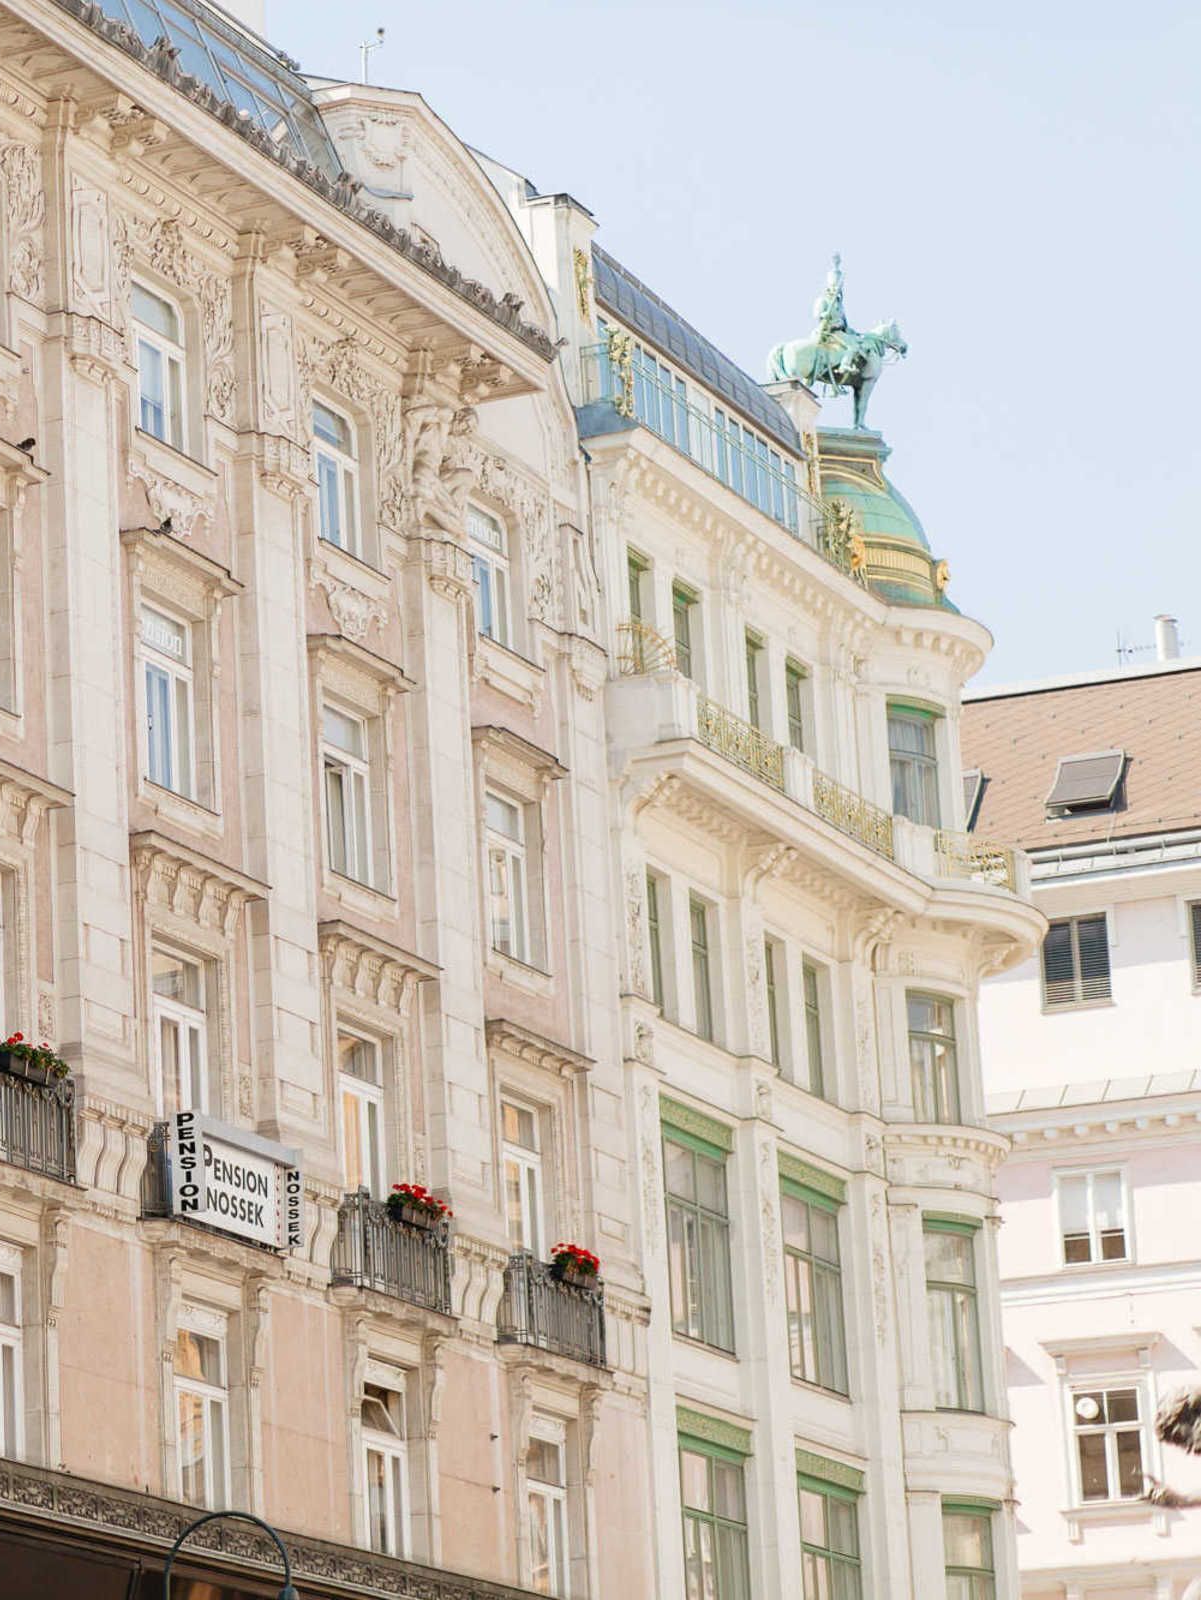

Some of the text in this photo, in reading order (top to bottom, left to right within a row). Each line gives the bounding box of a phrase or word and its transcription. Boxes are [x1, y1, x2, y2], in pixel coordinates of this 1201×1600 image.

[176, 1112, 200, 1212] PENSION
[206, 1186, 264, 1228] NOSSEK
[287, 1171, 301, 1245] NOSSEK
